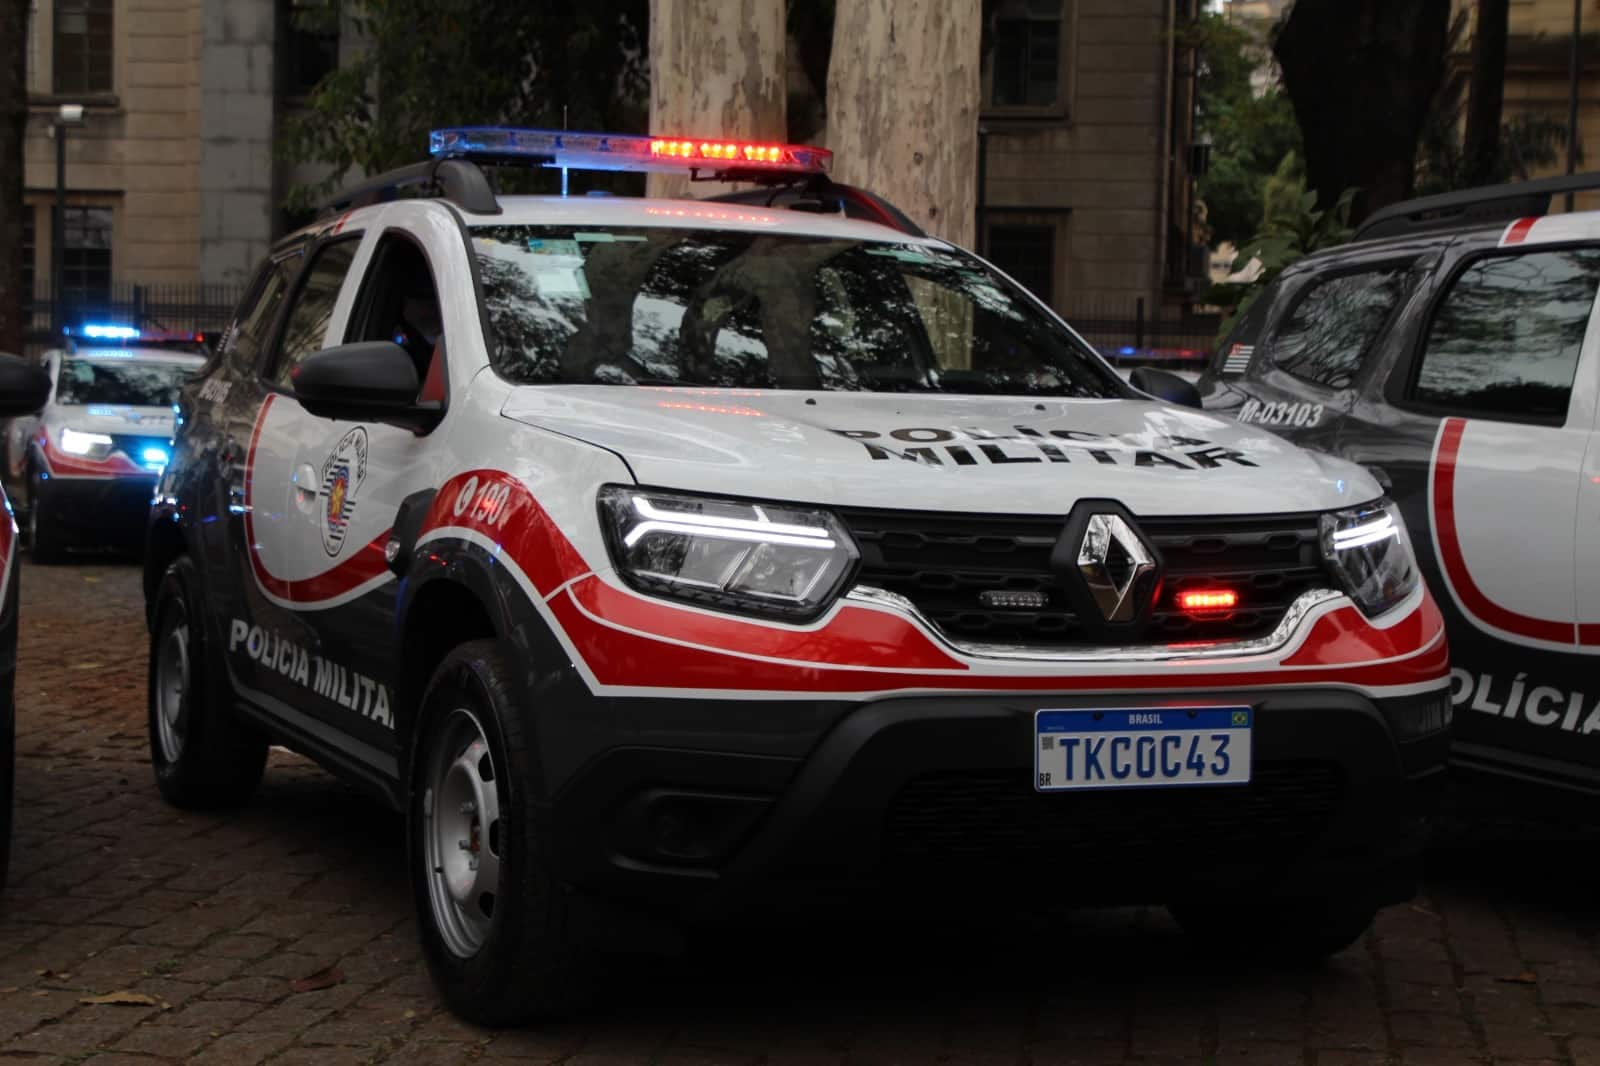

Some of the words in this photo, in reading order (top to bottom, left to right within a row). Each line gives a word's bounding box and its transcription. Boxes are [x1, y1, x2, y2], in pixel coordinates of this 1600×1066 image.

[1237, 400, 1322, 428] M-03103
[825, 427, 1211, 446] POLÍCA
[862, 443, 1260, 469] MILITAR
[470, 480, 510, 525] 190
[313, 656, 395, 730] MILITA
[1129, 714, 1162, 725] BRASIL
[1039, 773, 1052, 787] BR
